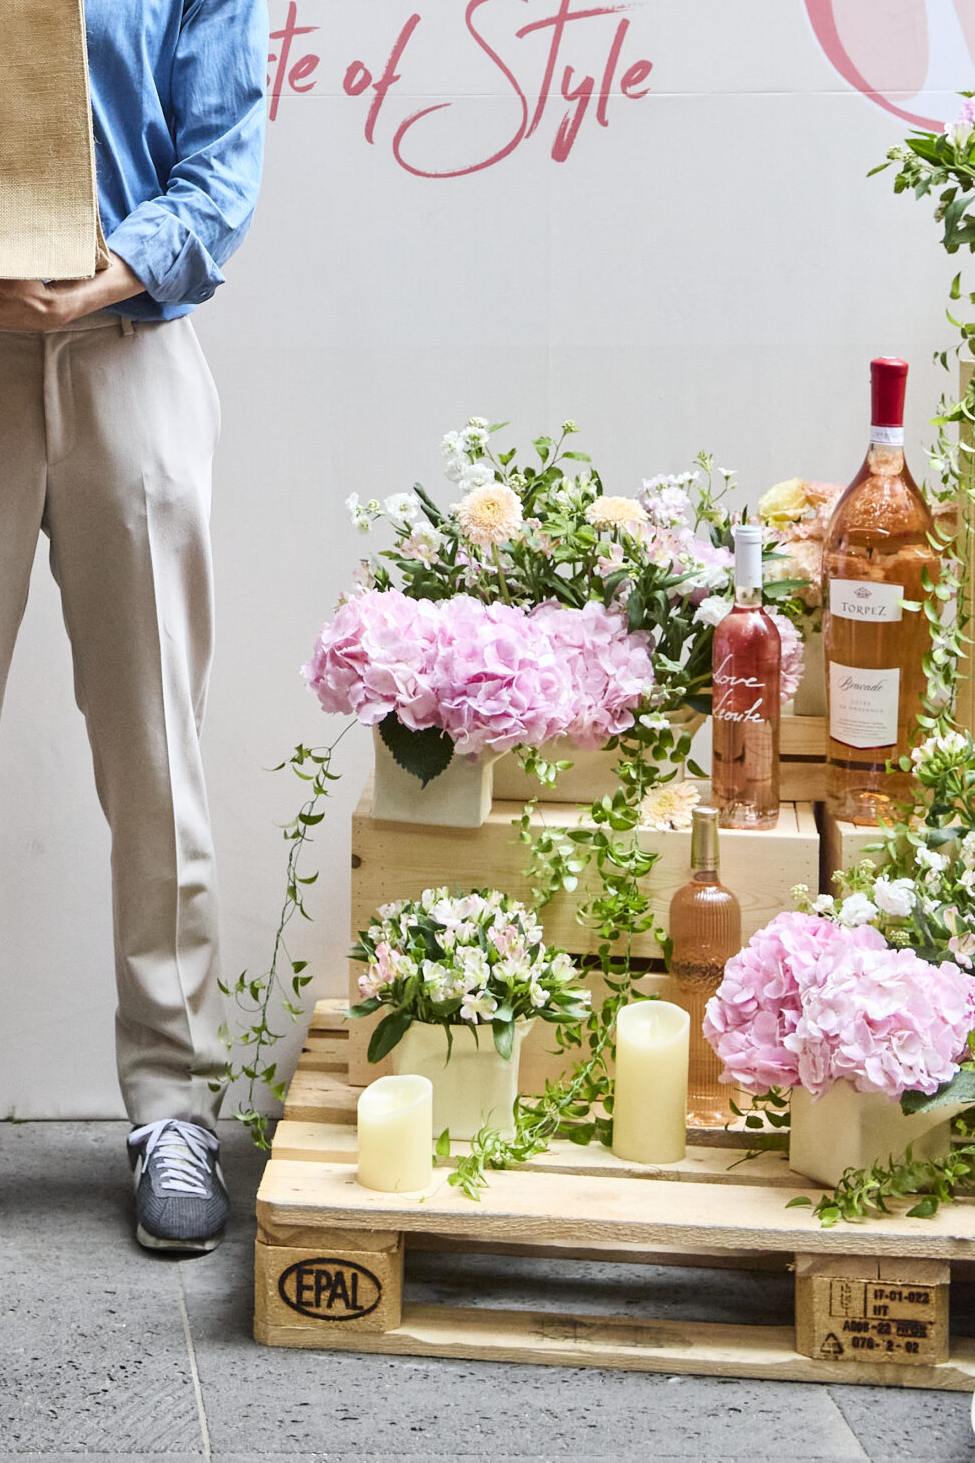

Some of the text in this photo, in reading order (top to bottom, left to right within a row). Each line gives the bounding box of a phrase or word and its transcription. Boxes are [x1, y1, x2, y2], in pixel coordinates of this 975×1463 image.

[342, 13, 422, 145] of
[841, 601, 886, 617] TORPEZ
[713, 653, 766, 687] Love
[296, 1266, 365, 1311] EPAL
